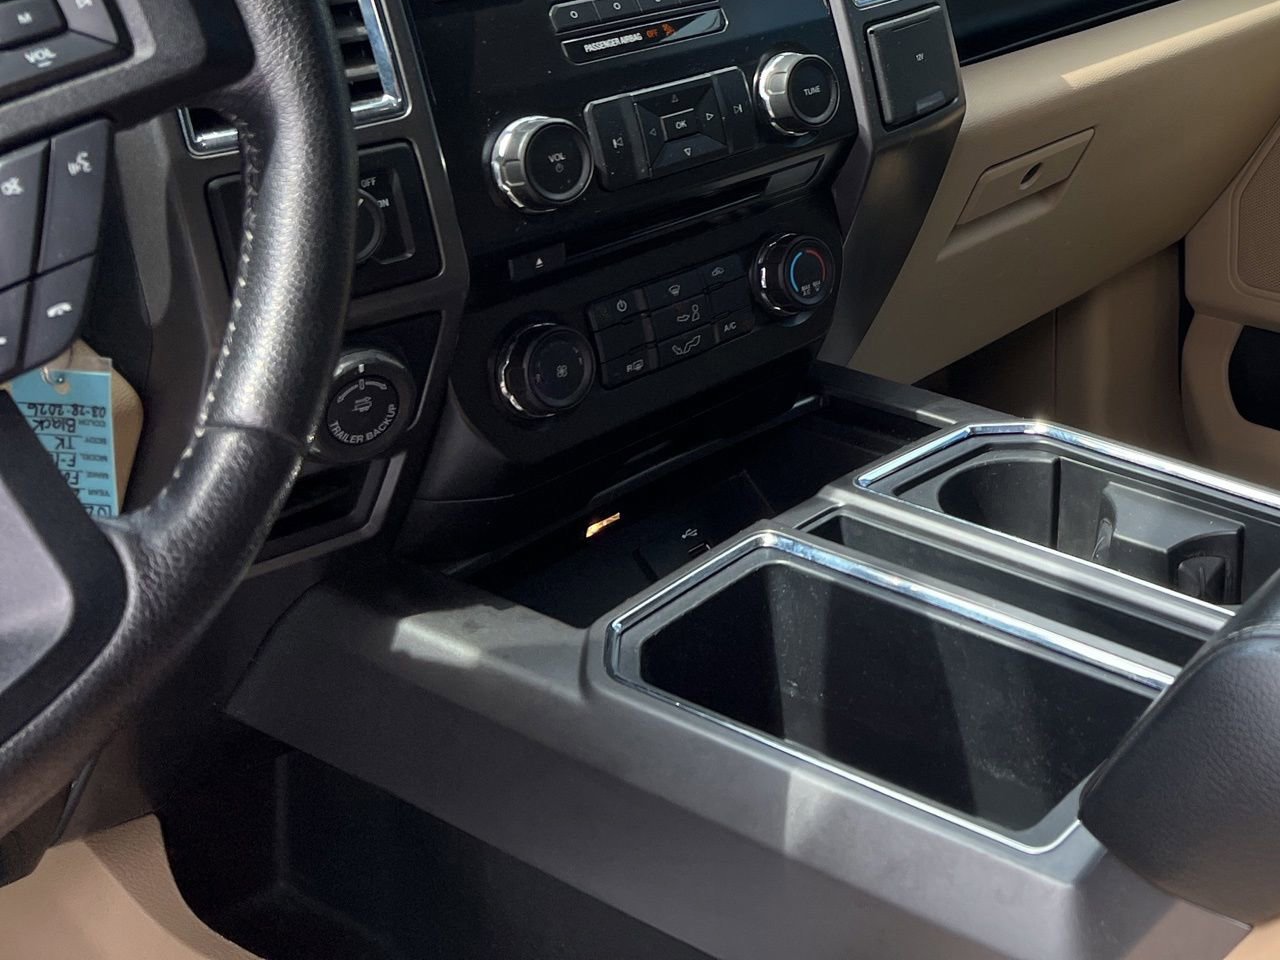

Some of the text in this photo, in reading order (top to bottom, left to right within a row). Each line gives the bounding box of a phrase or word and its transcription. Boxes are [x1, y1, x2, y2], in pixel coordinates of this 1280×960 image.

[17, 11, 33, 24] M
[584, 32, 643, 53] PASSENGER AIRBAG
[24, 47, 57, 63] VOL
[803, 85, 821, 97] TUNE
[675, 120, 688, 129] OK
[548, 152, 566, 163] VOL
[724, 321, 737, 332] A/C
[33, 418, 76, 433] Black
[329, 403, 397, 444] TRAILER BACKUP
